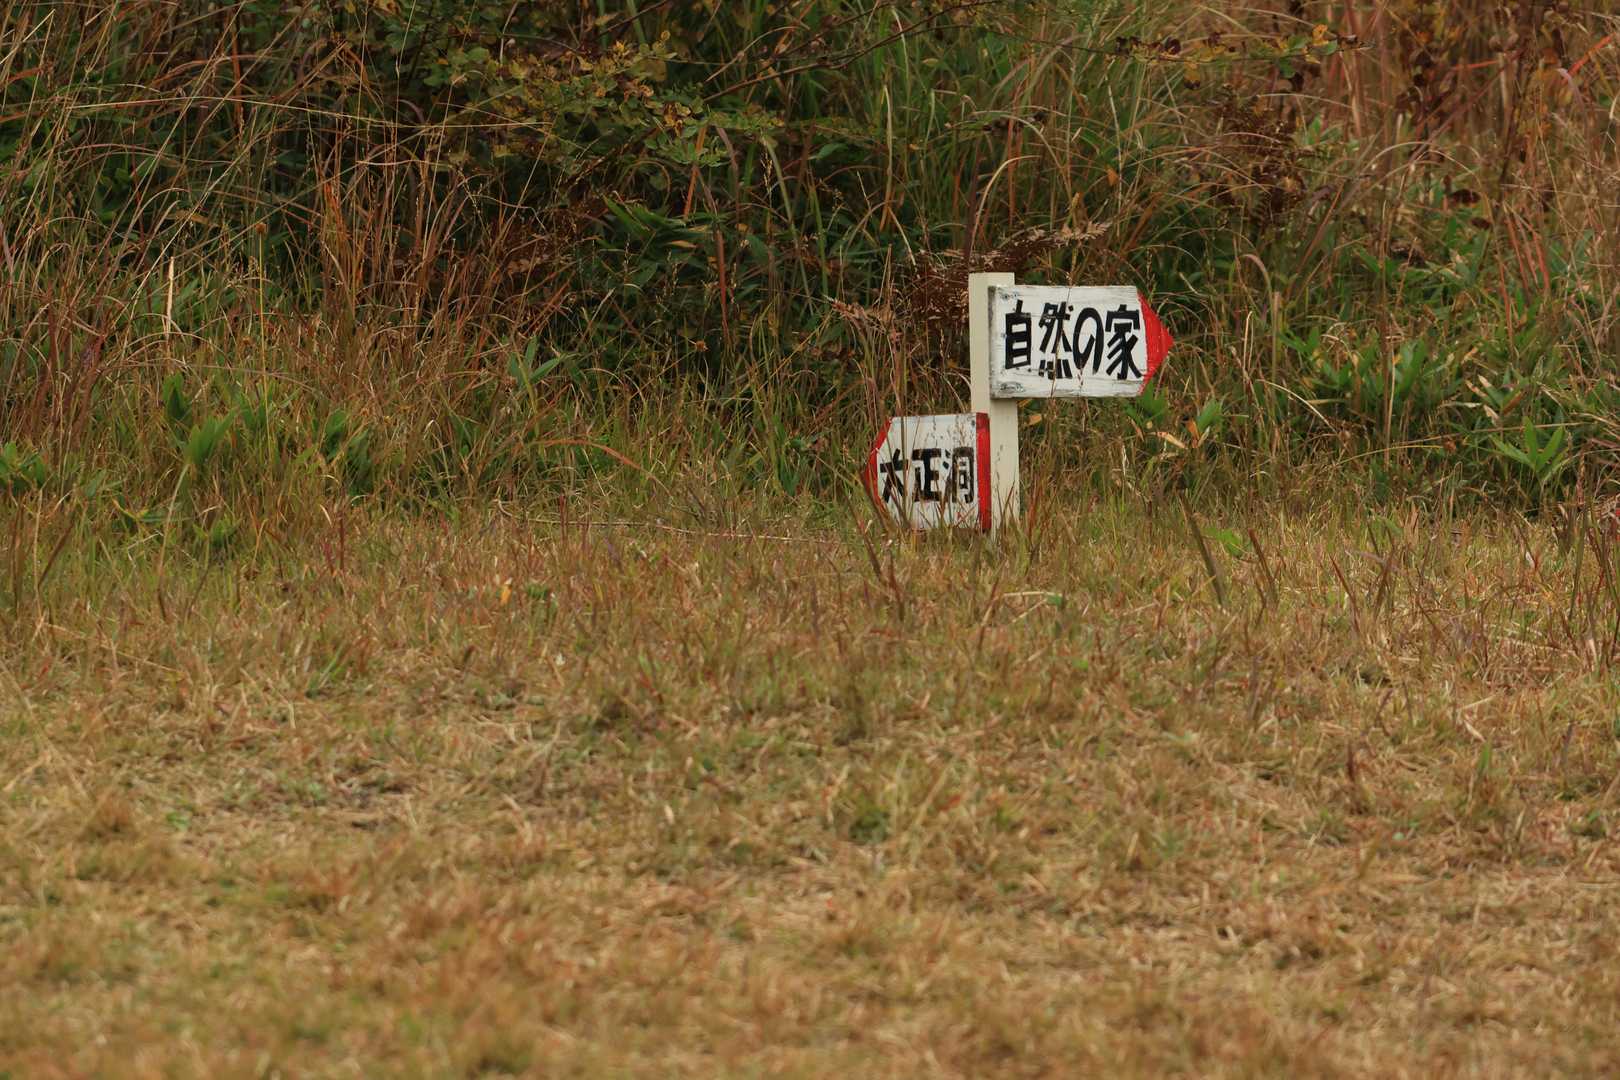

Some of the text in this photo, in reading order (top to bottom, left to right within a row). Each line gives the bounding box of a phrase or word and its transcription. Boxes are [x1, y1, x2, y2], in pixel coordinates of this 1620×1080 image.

[1005, 299, 1143, 380] 自然の家
[880, 446, 975, 504] 大正洞
